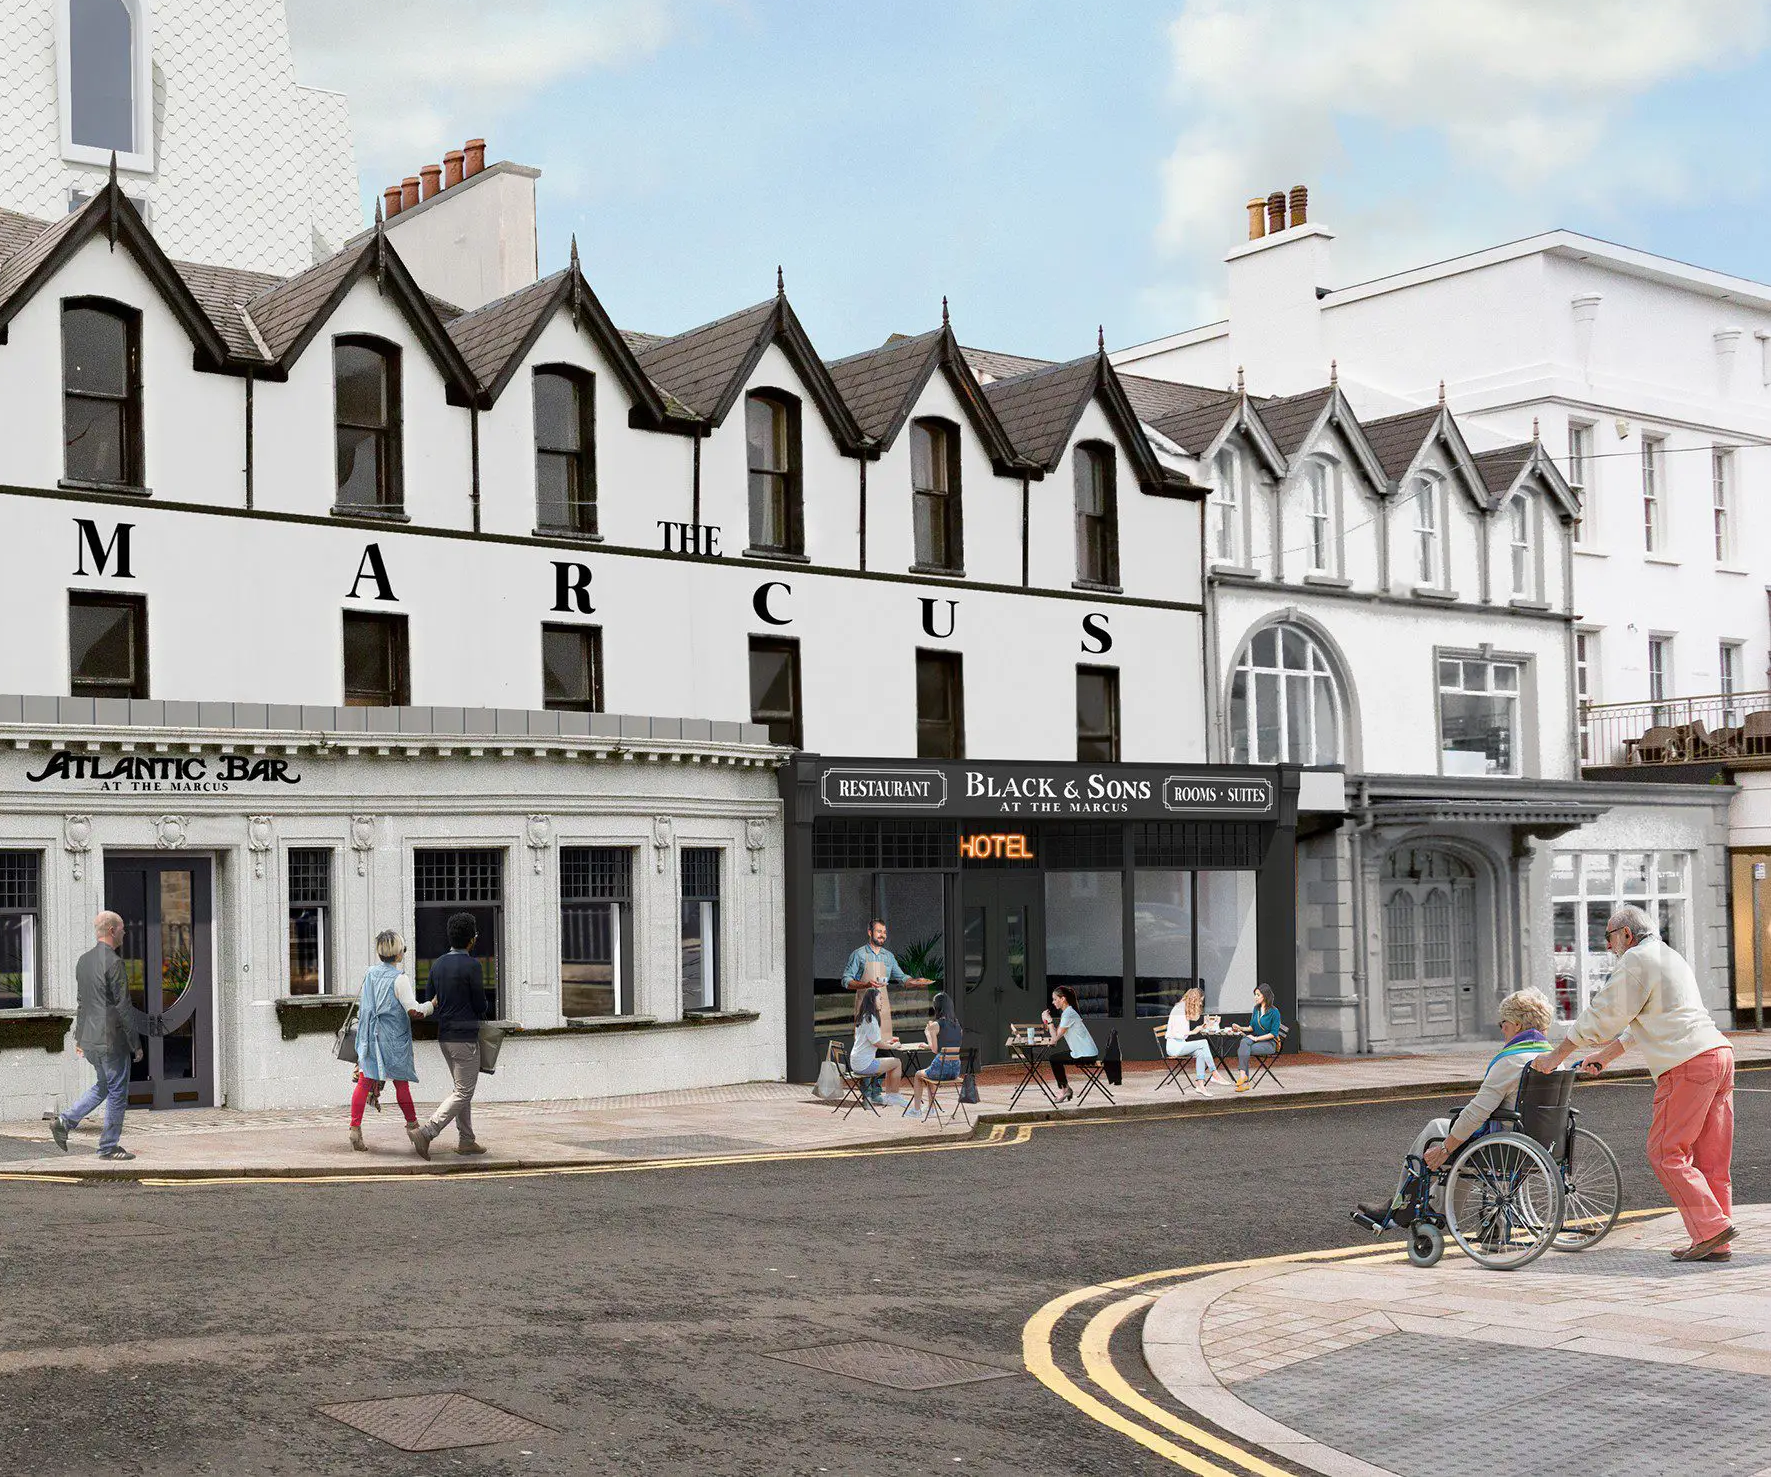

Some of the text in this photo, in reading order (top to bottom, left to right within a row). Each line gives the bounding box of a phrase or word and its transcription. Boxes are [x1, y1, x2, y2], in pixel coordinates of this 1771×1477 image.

[657, 521, 723, 557] THE
[26, 750, 302, 784] ATLANTIC BAR
[100, 781, 230, 792] AT THE MARCUS
[839, 779, 931, 797] RESTAURANT
[965, 772, 1152, 800] BLACK & SONS
[1174, 786, 1217, 802] ROOMS
[1227, 786, 1266, 803] SUITES
[1000, 802, 1129, 813] AT THE MARCUS
[959, 833, 1035, 859] HOTEL
